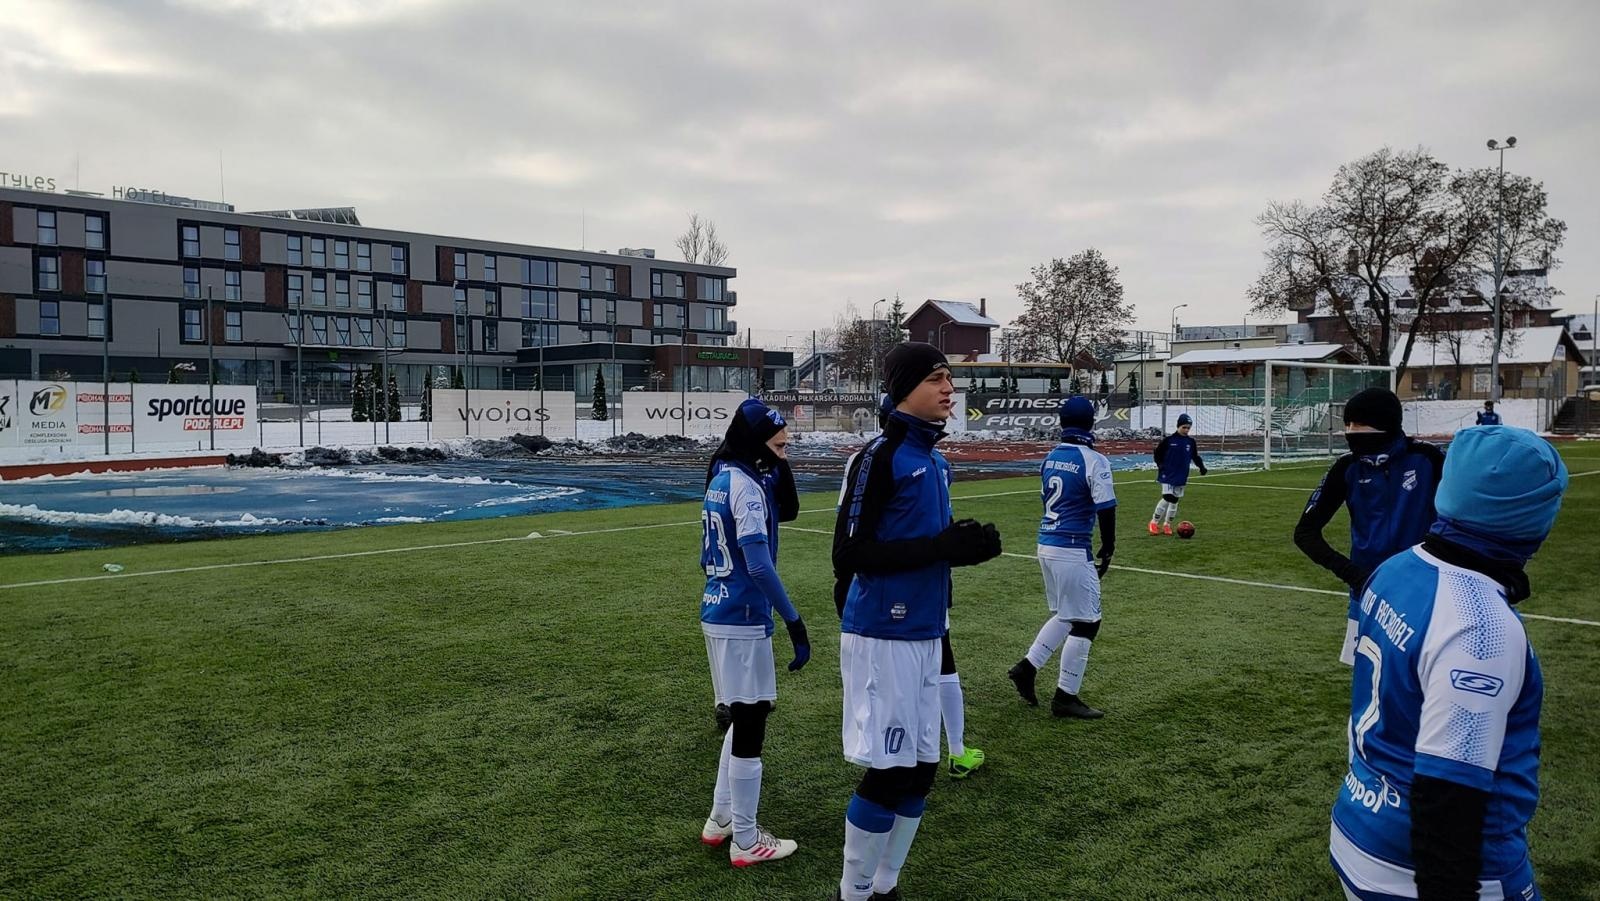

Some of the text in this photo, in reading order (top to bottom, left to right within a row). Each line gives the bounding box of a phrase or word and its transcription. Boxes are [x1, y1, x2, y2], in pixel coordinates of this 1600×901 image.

[112, 185, 168, 201] HOTEL
[147, 395, 246, 422] sportowe
[760, 394, 874, 402] AKADEMIA PIŁKARSKA PODHALA
[458, 400, 551, 424] wojas
[645, 401, 729, 421] wojas
[31, 421, 66, 429] MEDIA
[1045, 475, 1063, 520] 2
[702, 510, 734, 578] 23
[884, 726, 906, 755] 10
